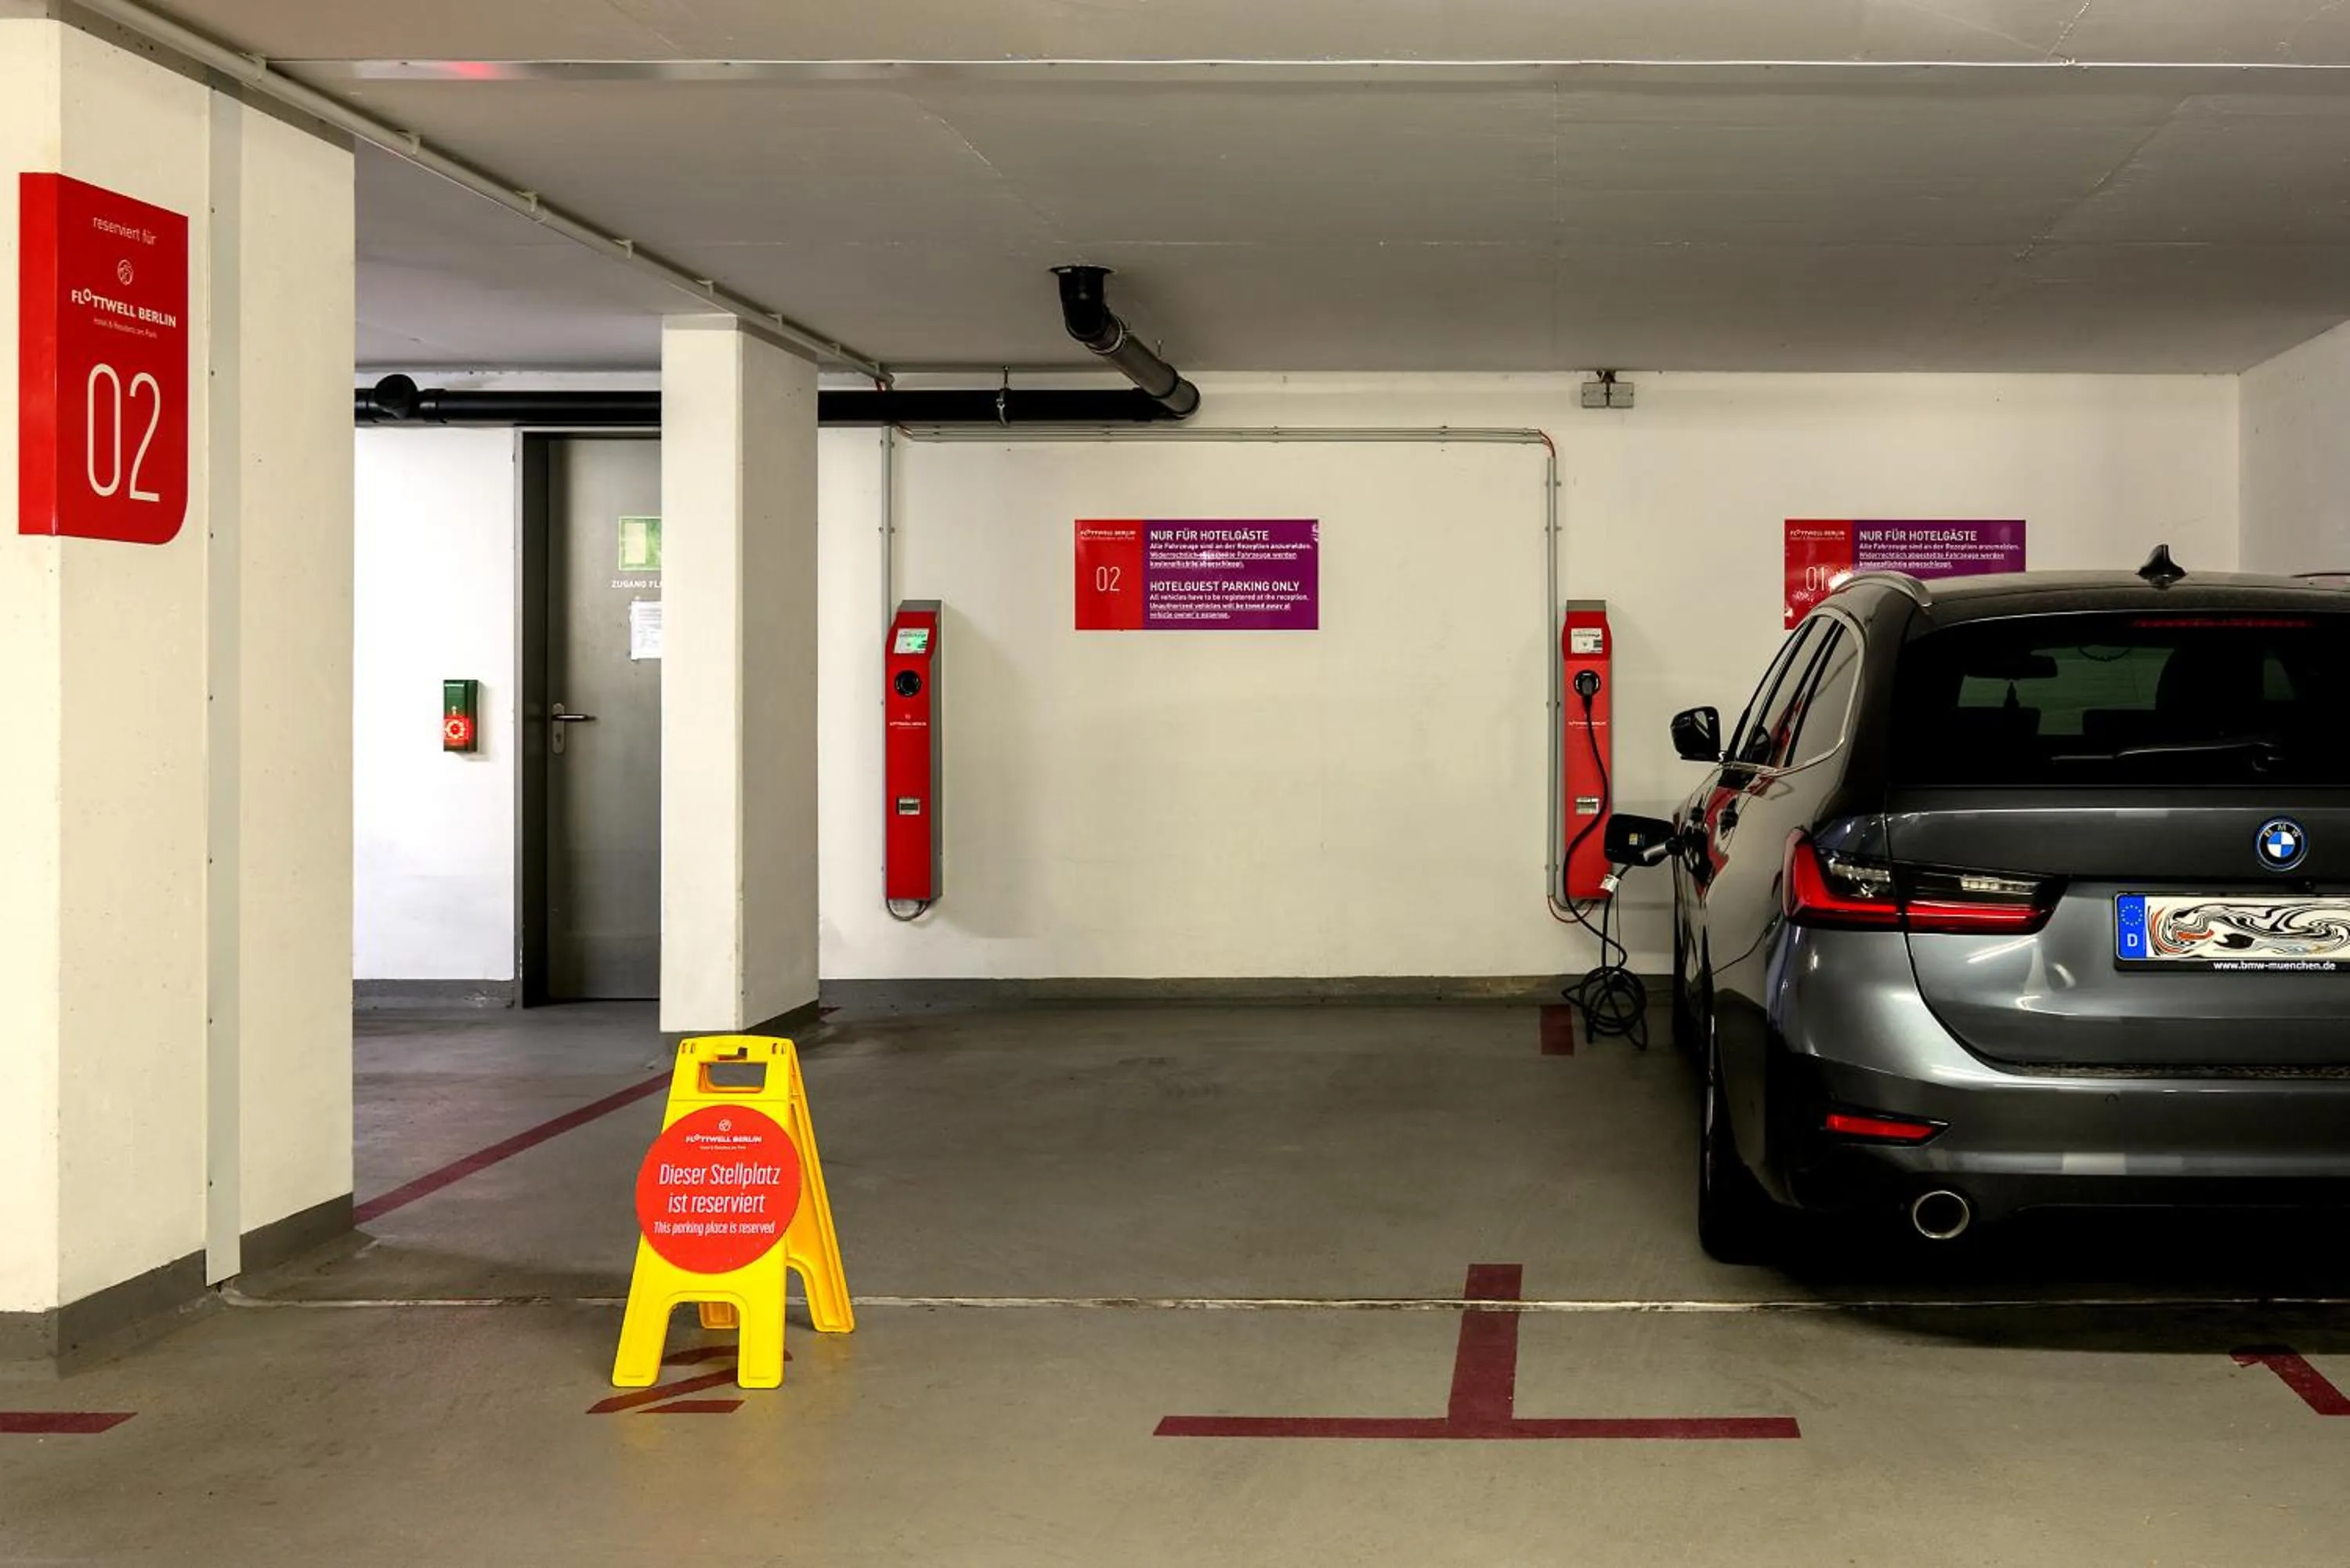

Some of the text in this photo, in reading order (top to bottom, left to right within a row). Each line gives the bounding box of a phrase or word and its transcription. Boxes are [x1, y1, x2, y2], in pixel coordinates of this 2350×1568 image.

[92, 217, 157, 245] reserviert für
[71, 287, 176, 328] FLOTTWELL BERLIN
[86, 362, 161, 503] 02
[1151, 528, 1270, 541] NUR FÜR HOTELGÄSTE
[1859, 528, 1978, 541] NUR FÜR HOTELGÄSTE
[1096, 566, 1121, 591] 02
[1150, 580, 1300, 591] HOTELGUEST PARKING ONLY
[1805, 566, 1825, 591] 01
[2264, 824, 2301, 837] BMW
[2127, 933, 2138, 947] D
[2213, 961, 2337, 971] www.bmw-muenchen.de
[686, 1133, 762, 1143] FLOTTWELL BERLIN
[659, 1162, 781, 1189] Dieser Stellplatz
[668, 1192, 765, 1213] ist reserviert
[654, 1221, 776, 1236] This parking place is reserved
